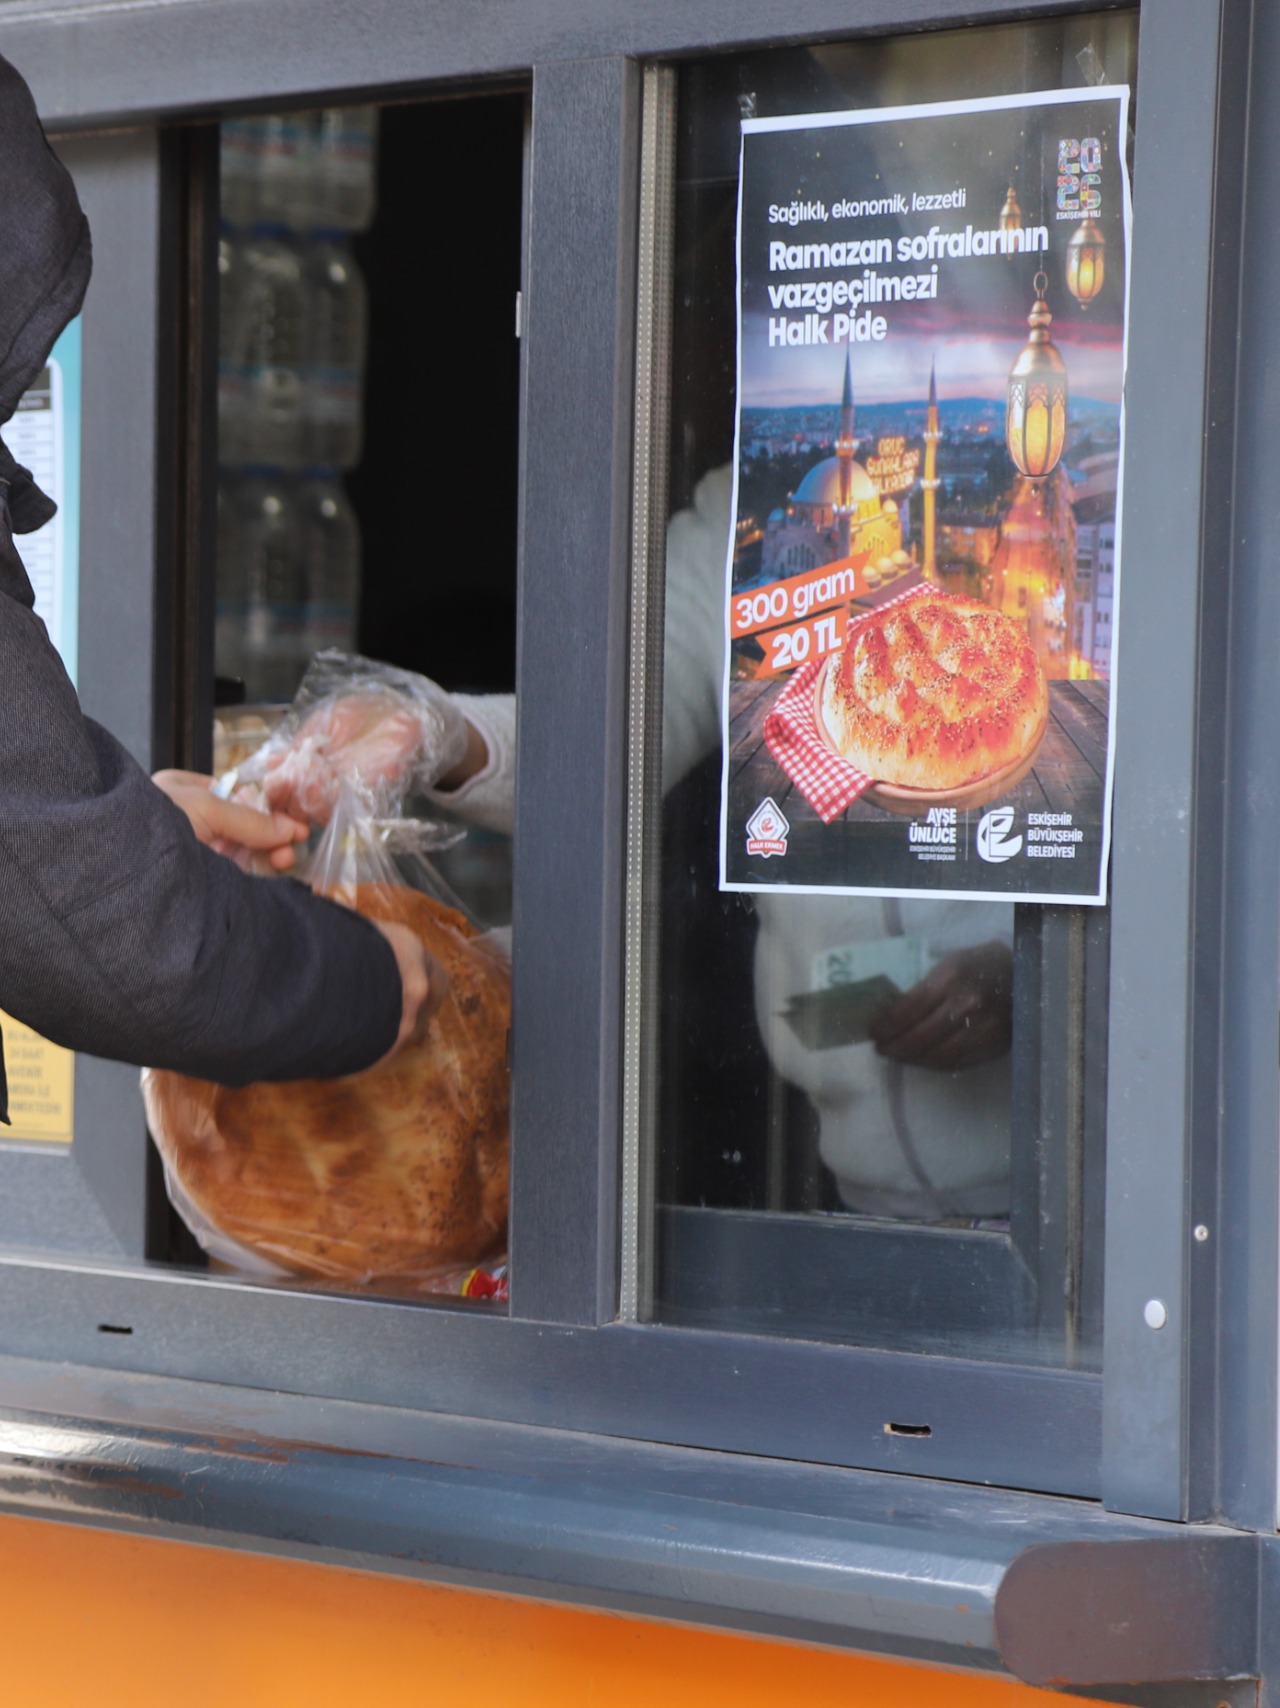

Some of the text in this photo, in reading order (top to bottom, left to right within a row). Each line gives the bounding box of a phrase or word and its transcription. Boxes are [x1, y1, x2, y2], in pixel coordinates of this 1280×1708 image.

[1057, 137, 1102, 174] 20
[769, 188, 966, 226] Sağlıklı, ekonomik, lezzetli
[769, 225, 1049, 271] Ramazan sofralarının
[768, 265, 938, 313] vazgeçilmezi
[769, 309, 887, 347] Halk Pide
[736, 568, 855, 628] 300 gram
[771, 616, 842, 669] 20 TL
[909, 823, 957, 844] ÜNLÜCE
[926, 808, 957, 826] AYŞE
[1027, 812, 1073, 827] ESKİŞEHİR
[1027, 827, 1083, 843] BÜYÜKŞEHİR
[1027, 844, 1076, 859] BELEDİYESİ
